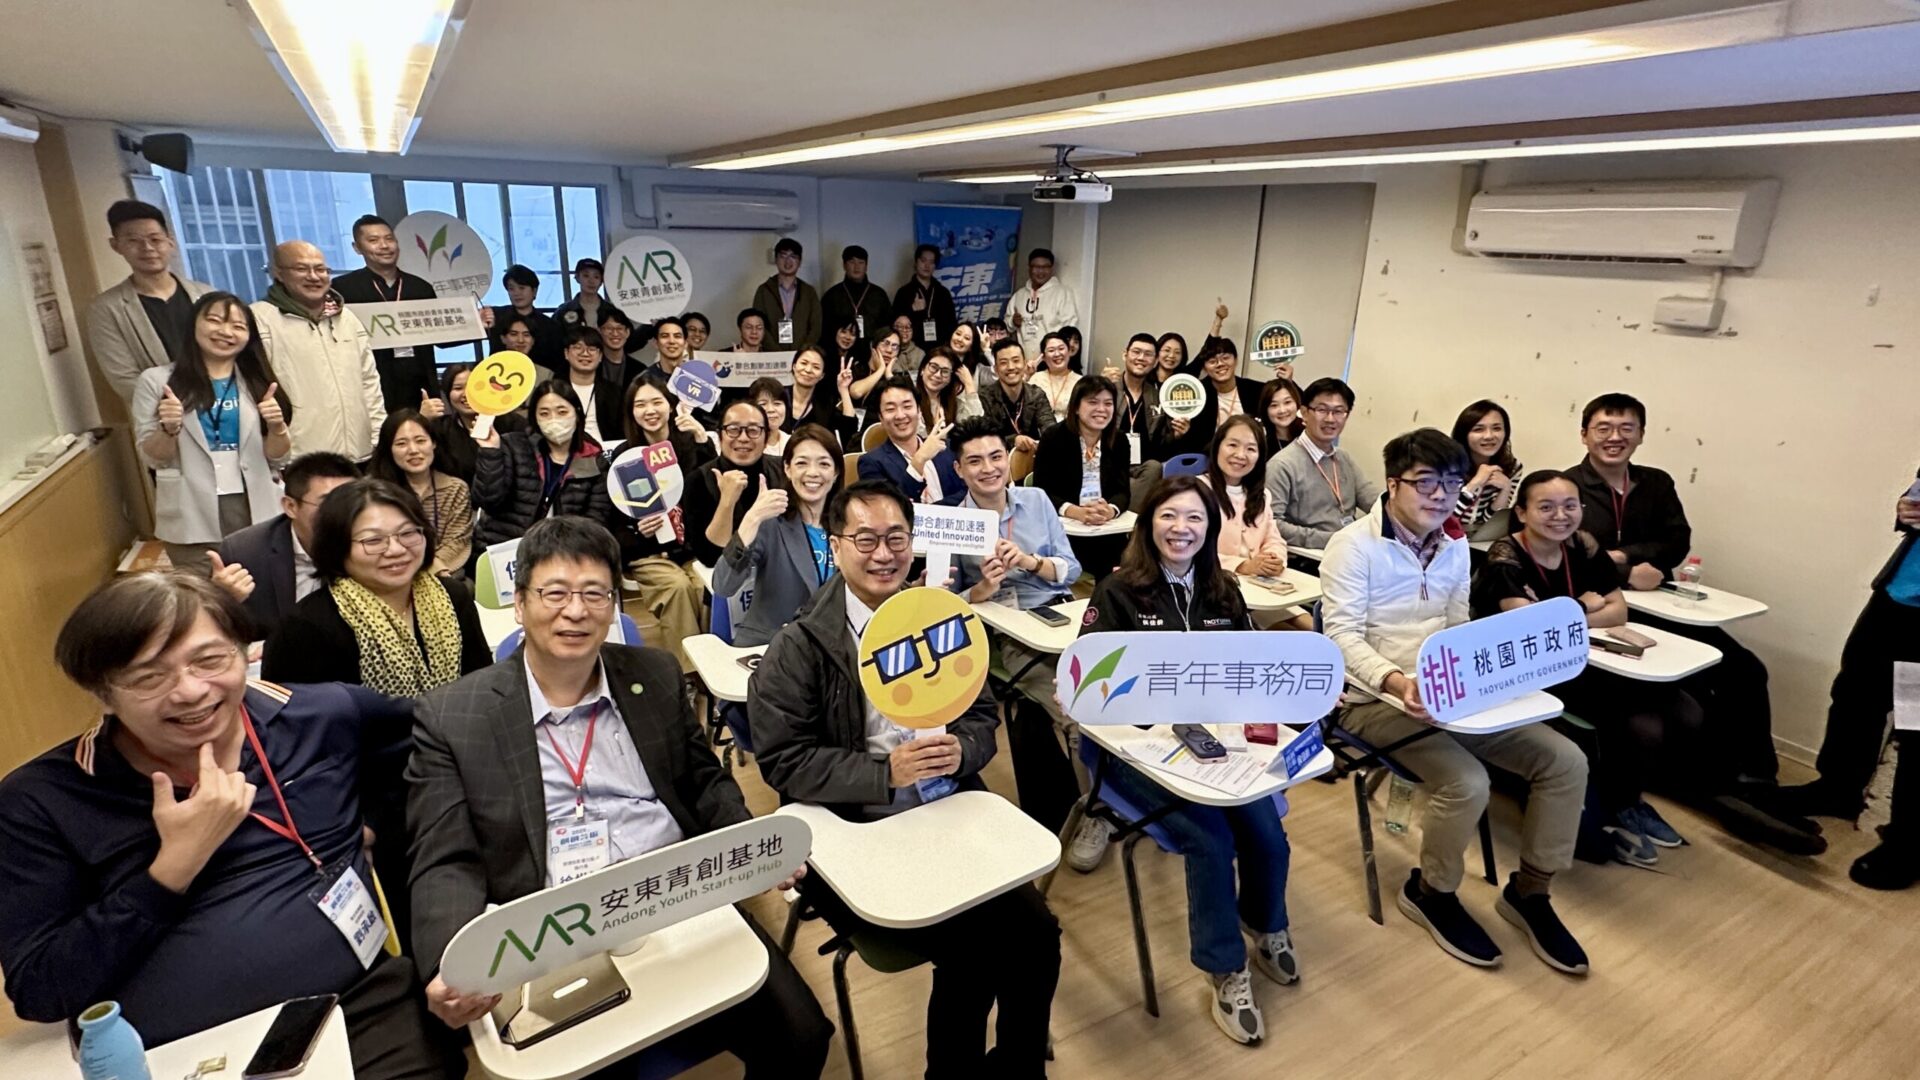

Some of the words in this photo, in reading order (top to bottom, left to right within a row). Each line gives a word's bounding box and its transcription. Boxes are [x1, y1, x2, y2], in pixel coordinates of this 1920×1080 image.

[618, 283, 685, 300] 安東青創基地
[400, 316, 466, 329] 安東青創基地
[687, 384, 702, 397] VR
[649, 447, 673, 467] AR
[914, 515, 985, 533] 聯合創新加速器
[913, 528, 940, 539] United
[943, 530, 985, 543] Innovation
[1473, 621, 1584, 677] 桃園市政府
[1145, 660, 1334, 696] 青年事務局
[1478, 679, 1516, 697] TAOYUAN
[1517, 671, 1535, 684] CITY
[1537, 653, 1587, 677] GOVERNMENT
[600, 834, 784, 917] 安東青創基地
[602, 903, 656, 931] Andong
[660, 889, 698, 908] Youth
[701, 870, 754, 894] Start-up
[757, 860, 783, 874] Hub
